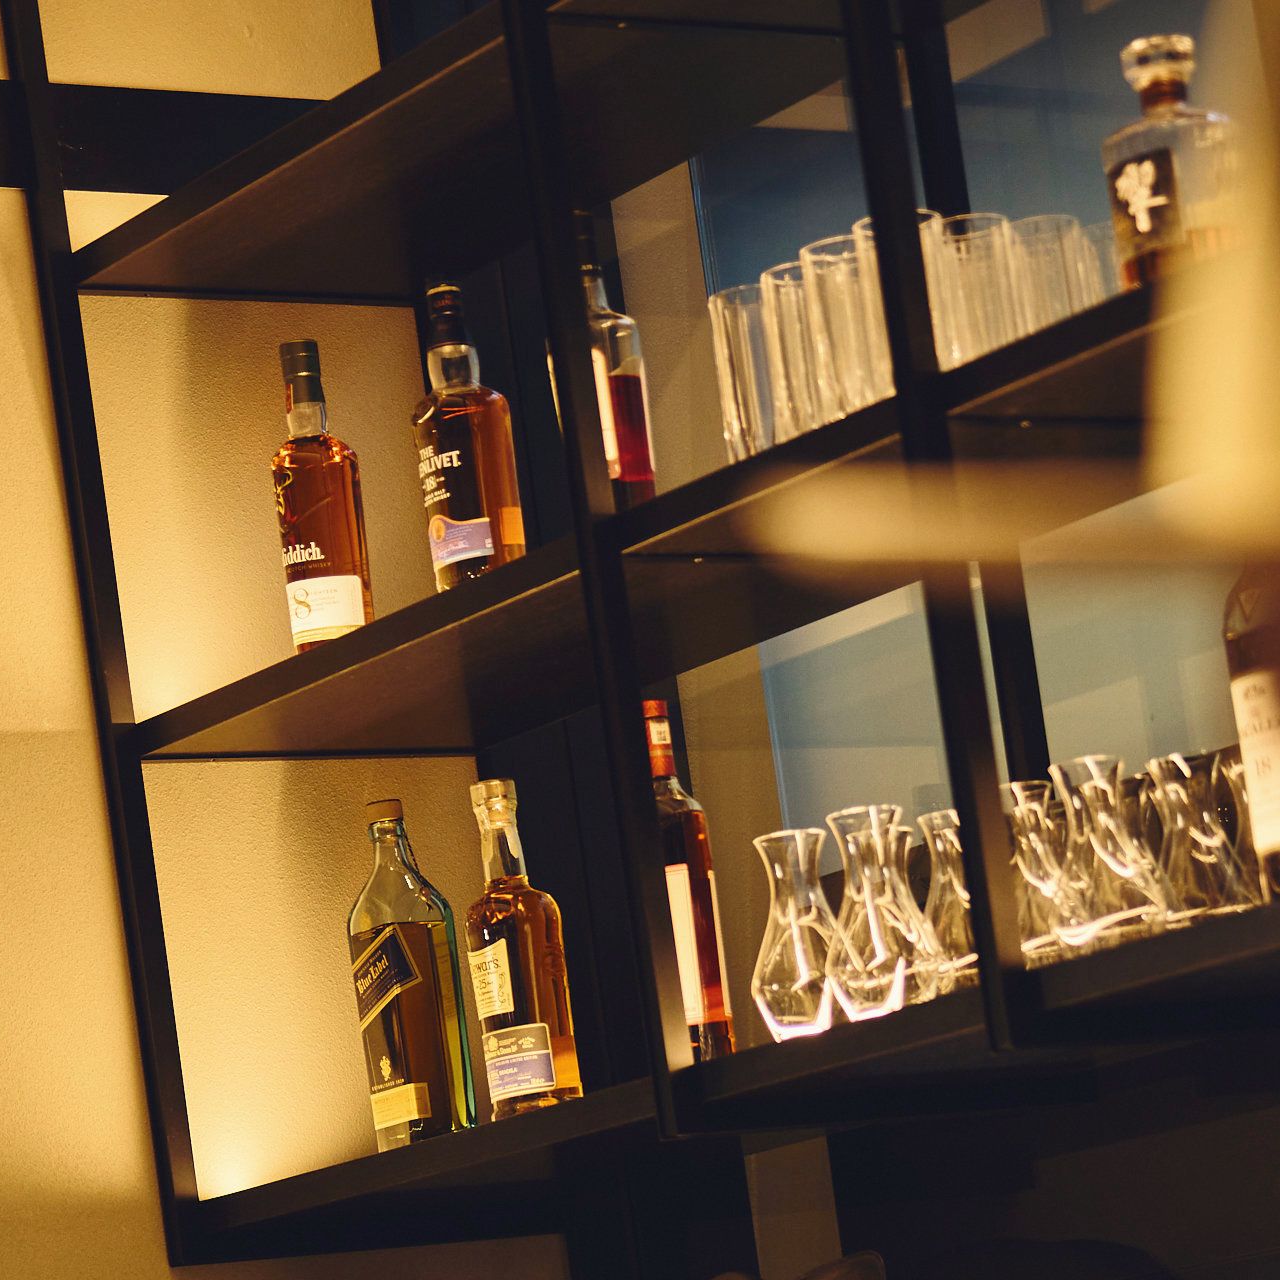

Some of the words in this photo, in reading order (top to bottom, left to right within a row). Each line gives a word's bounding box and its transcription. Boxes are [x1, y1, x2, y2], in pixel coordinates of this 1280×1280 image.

[419, 445, 435, 461] THE
[356, 973, 372, 996] Blue
[369, 954, 389, 982] Label
